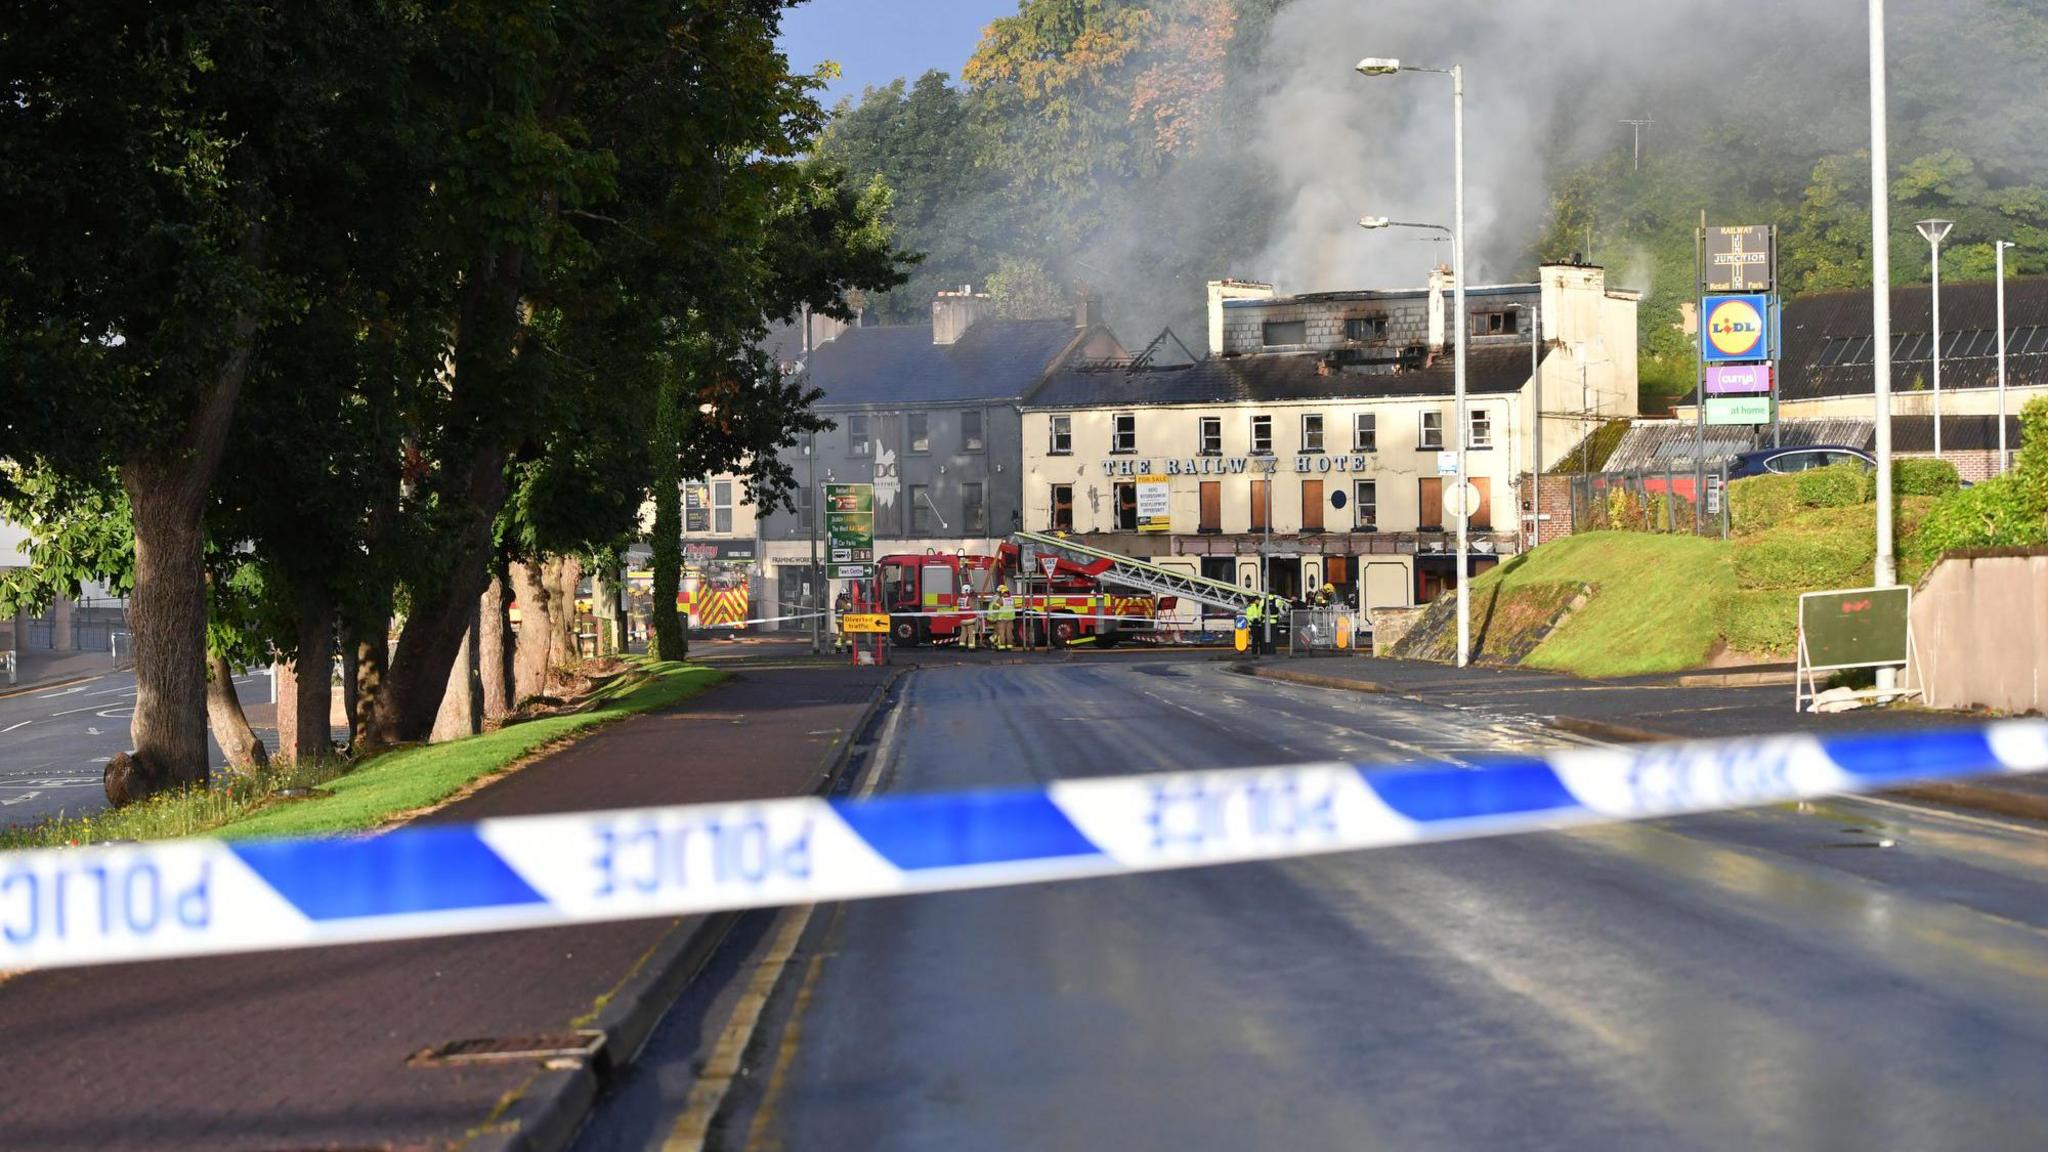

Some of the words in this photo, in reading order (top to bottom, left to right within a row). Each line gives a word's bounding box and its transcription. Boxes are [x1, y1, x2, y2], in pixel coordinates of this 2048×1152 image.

[1720, 226, 1753, 235] RAILWAY
[1714, 254, 1766, 263] JUNCTION
[1731, 405, 1739, 414] at
[1741, 404, 1765, 414] home
[1103, 459, 1151, 476] THE
[1166, 456, 1278, 475] RAILWY
[592, 818, 813, 896] POLICE
